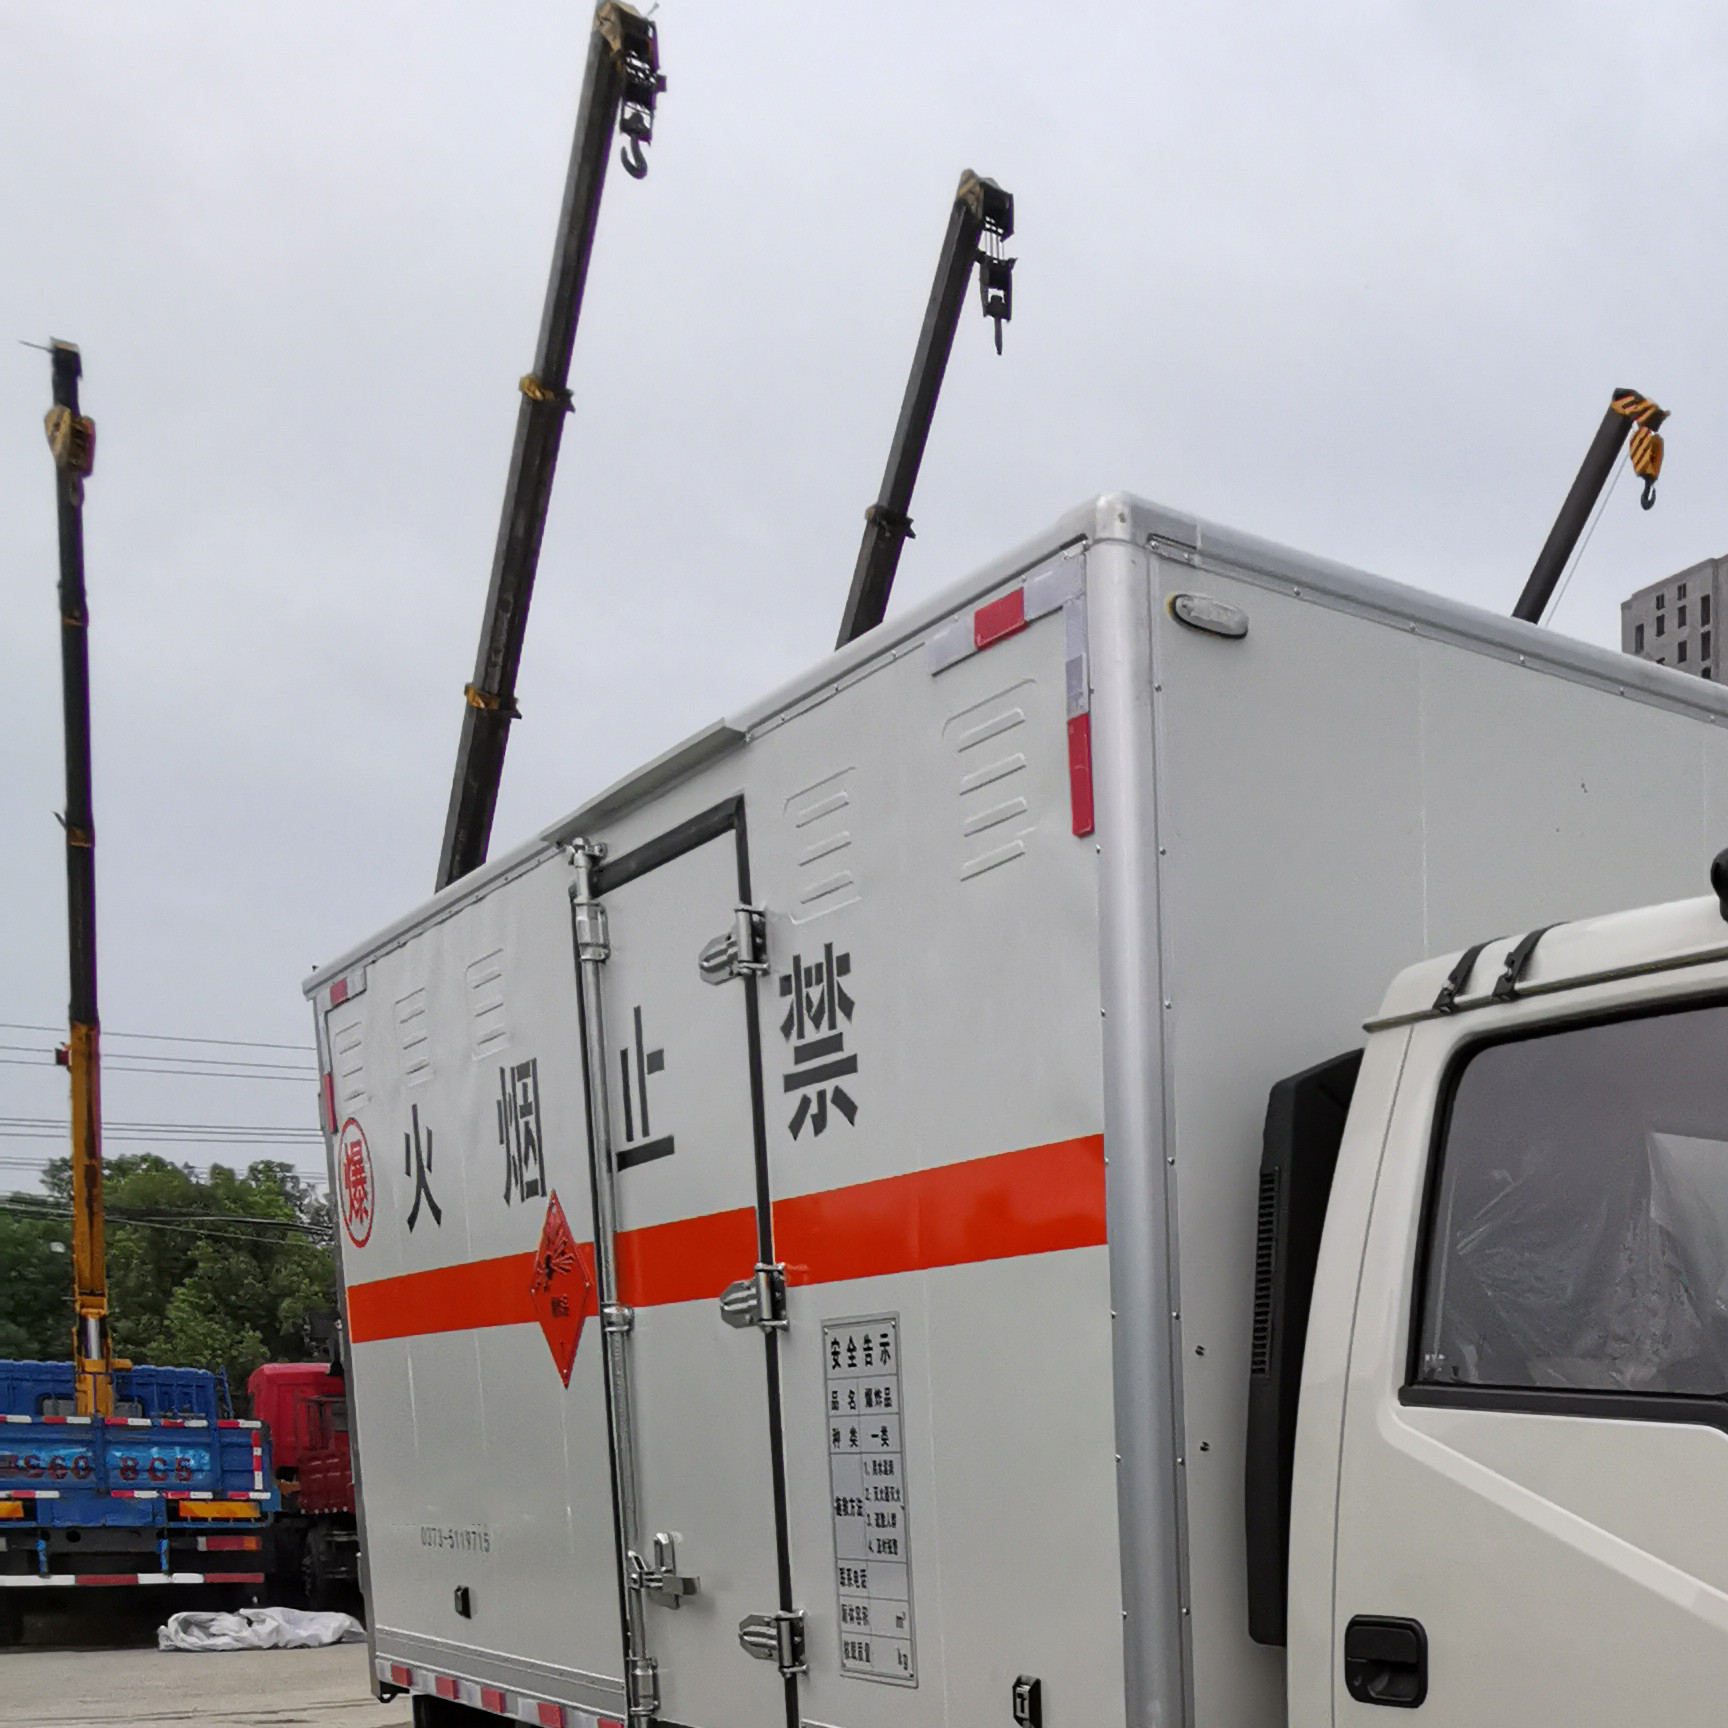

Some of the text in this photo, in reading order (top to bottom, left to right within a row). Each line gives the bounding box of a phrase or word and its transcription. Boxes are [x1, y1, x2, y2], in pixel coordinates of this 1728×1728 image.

[830, 1332, 892, 1371] 安全告示
[870, 1424, 890, 1448] 一类
